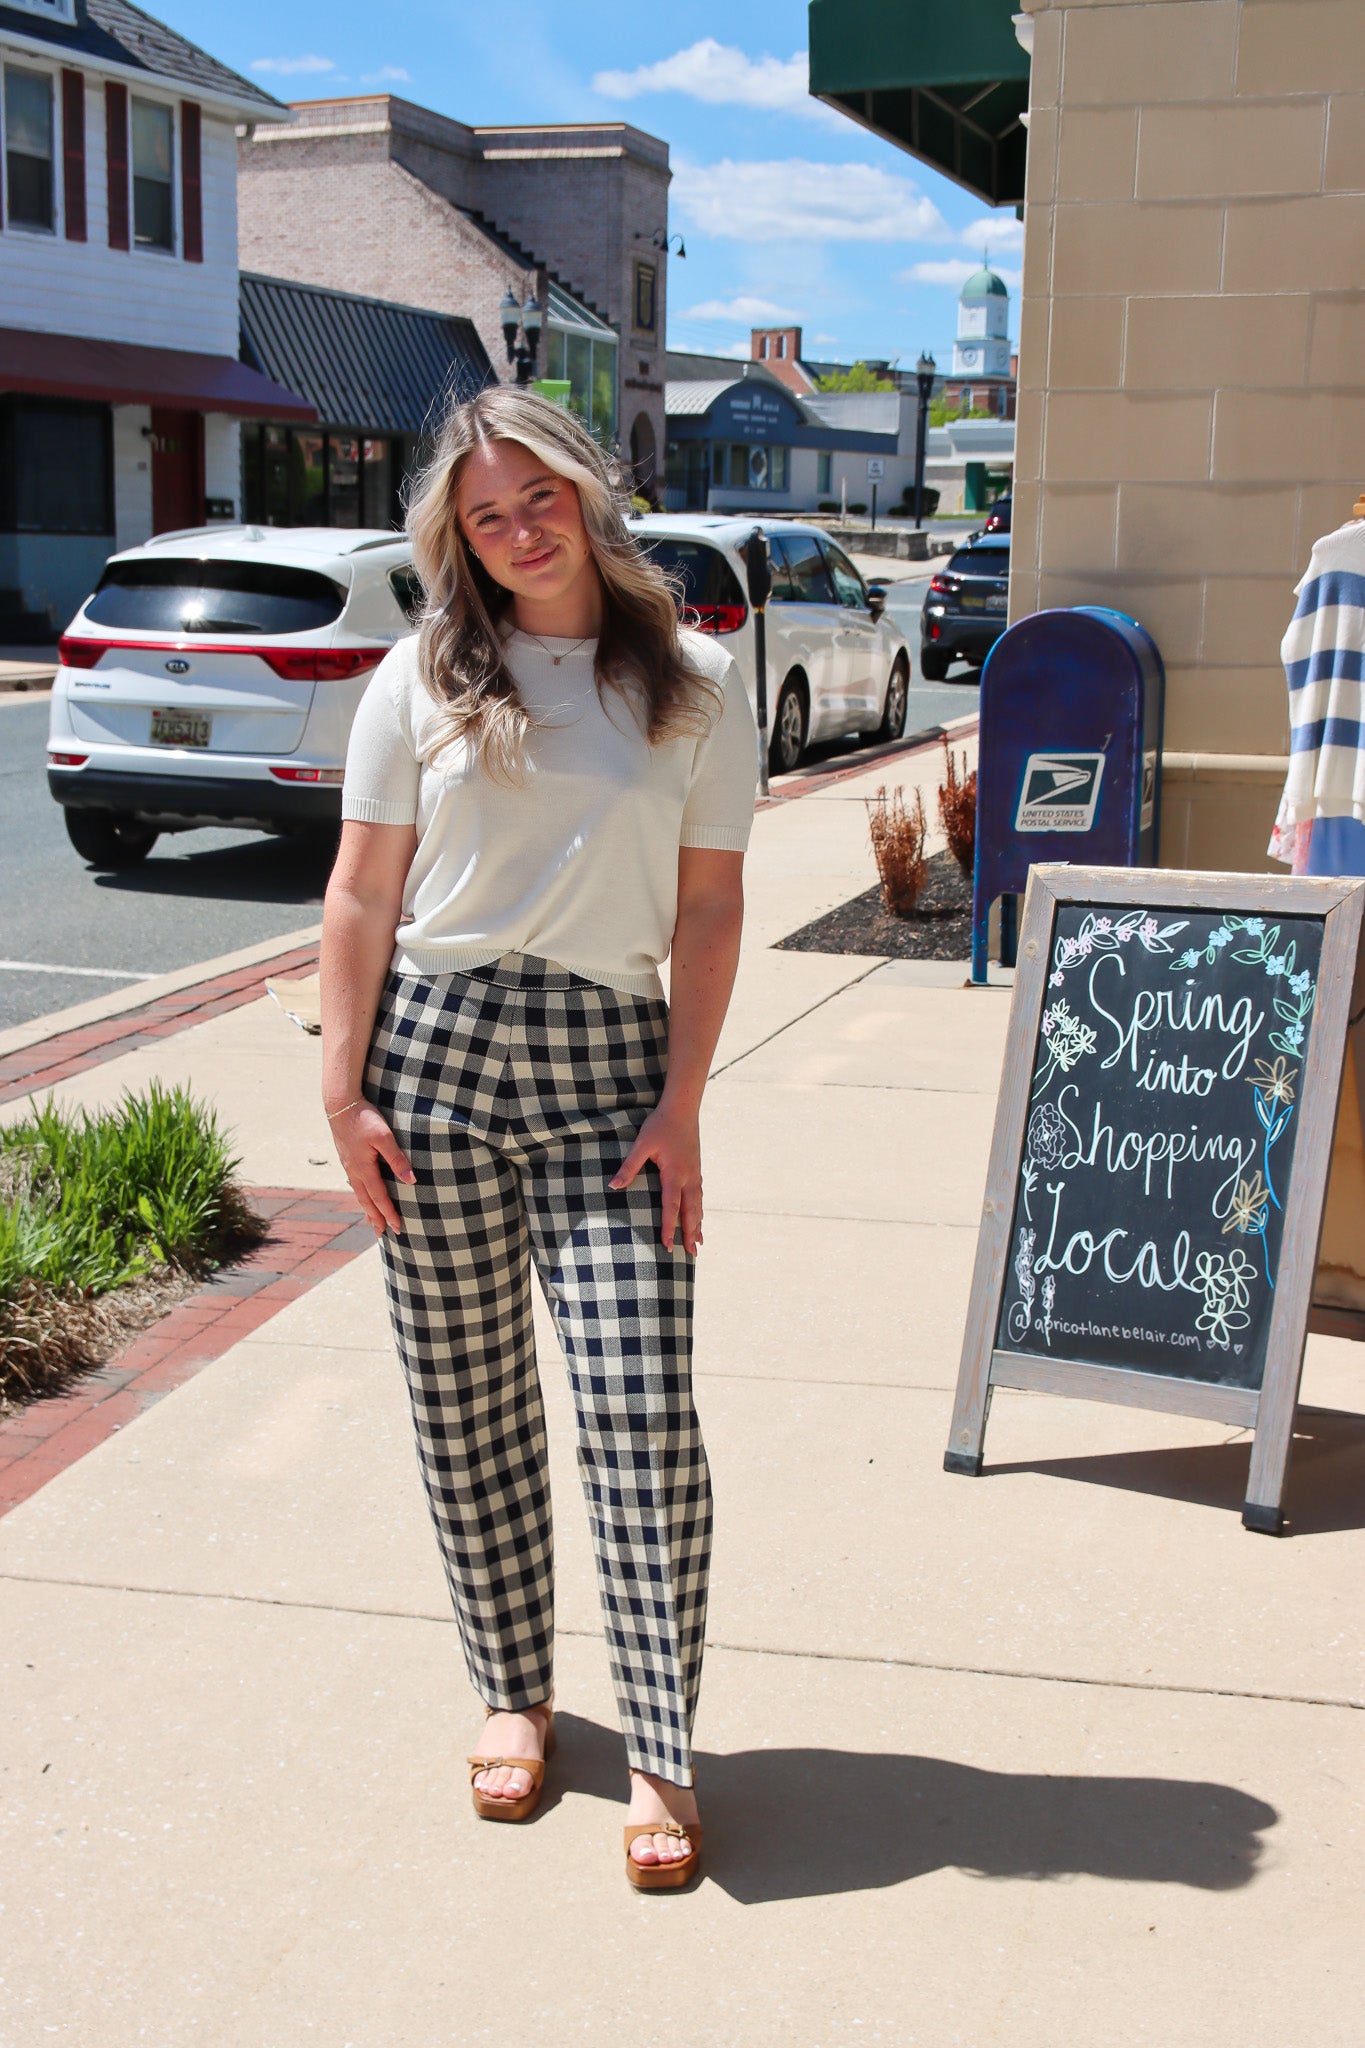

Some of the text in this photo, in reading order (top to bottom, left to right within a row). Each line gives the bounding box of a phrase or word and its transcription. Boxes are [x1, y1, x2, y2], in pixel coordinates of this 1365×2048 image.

[166, 662, 187, 673] KIA
[1088, 953, 1265, 1080] Spring
[1135, 1049, 1217, 1097] into
[1057, 1084, 1256, 1219] Shopping
[1033, 1181, 1203, 1293] Local
